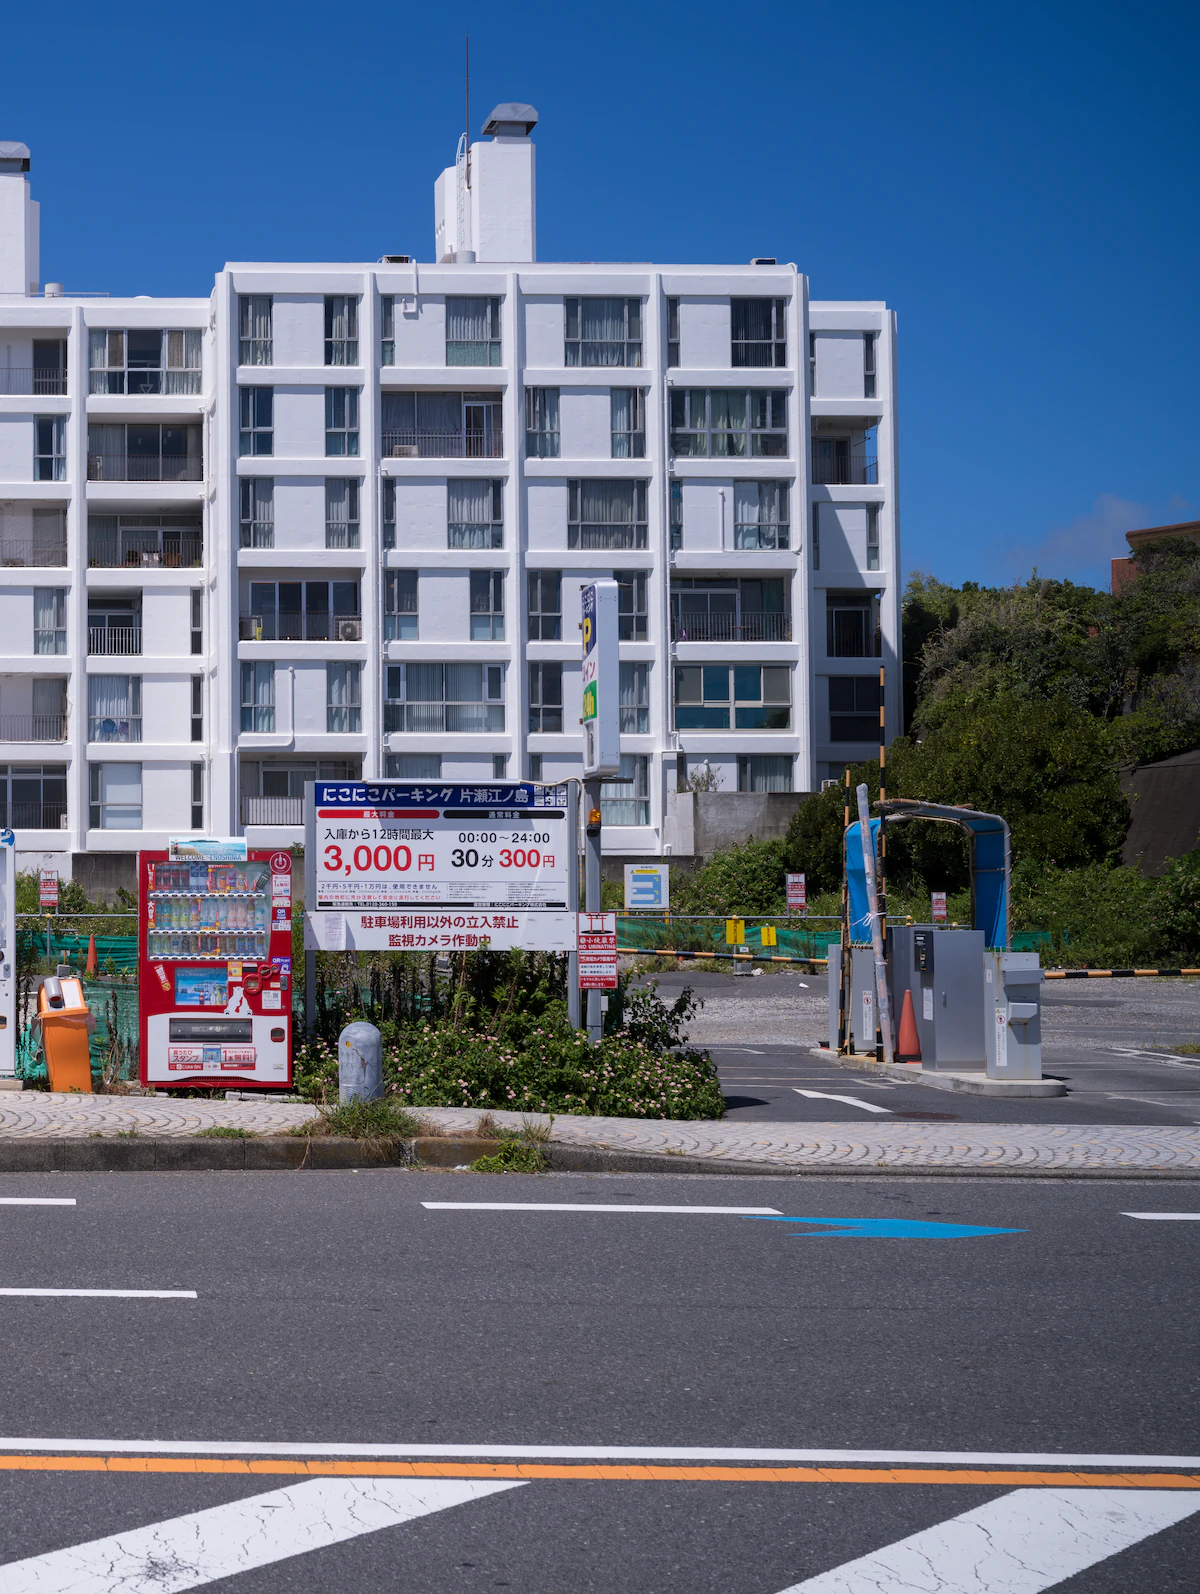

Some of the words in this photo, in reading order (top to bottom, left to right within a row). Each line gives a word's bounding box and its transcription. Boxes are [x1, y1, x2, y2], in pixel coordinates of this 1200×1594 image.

[323, 787, 453, 803] にこにこパーキング
[460, 788, 529, 804] 片瀬江ノ島
[363, 810, 395, 819] 最大料金
[488, 811, 520, 819] 通常料金
[324, 828, 434, 841] 入庫から12時間最大
[323, 845, 435, 876] 3,000円
[451, 849, 494, 868] 30分
[499, 849, 555, 868] 300円
[361, 915, 519, 929] 駐車場利用以外の立入禁止
[388, 934, 492, 947] 監視カメラ作動中
